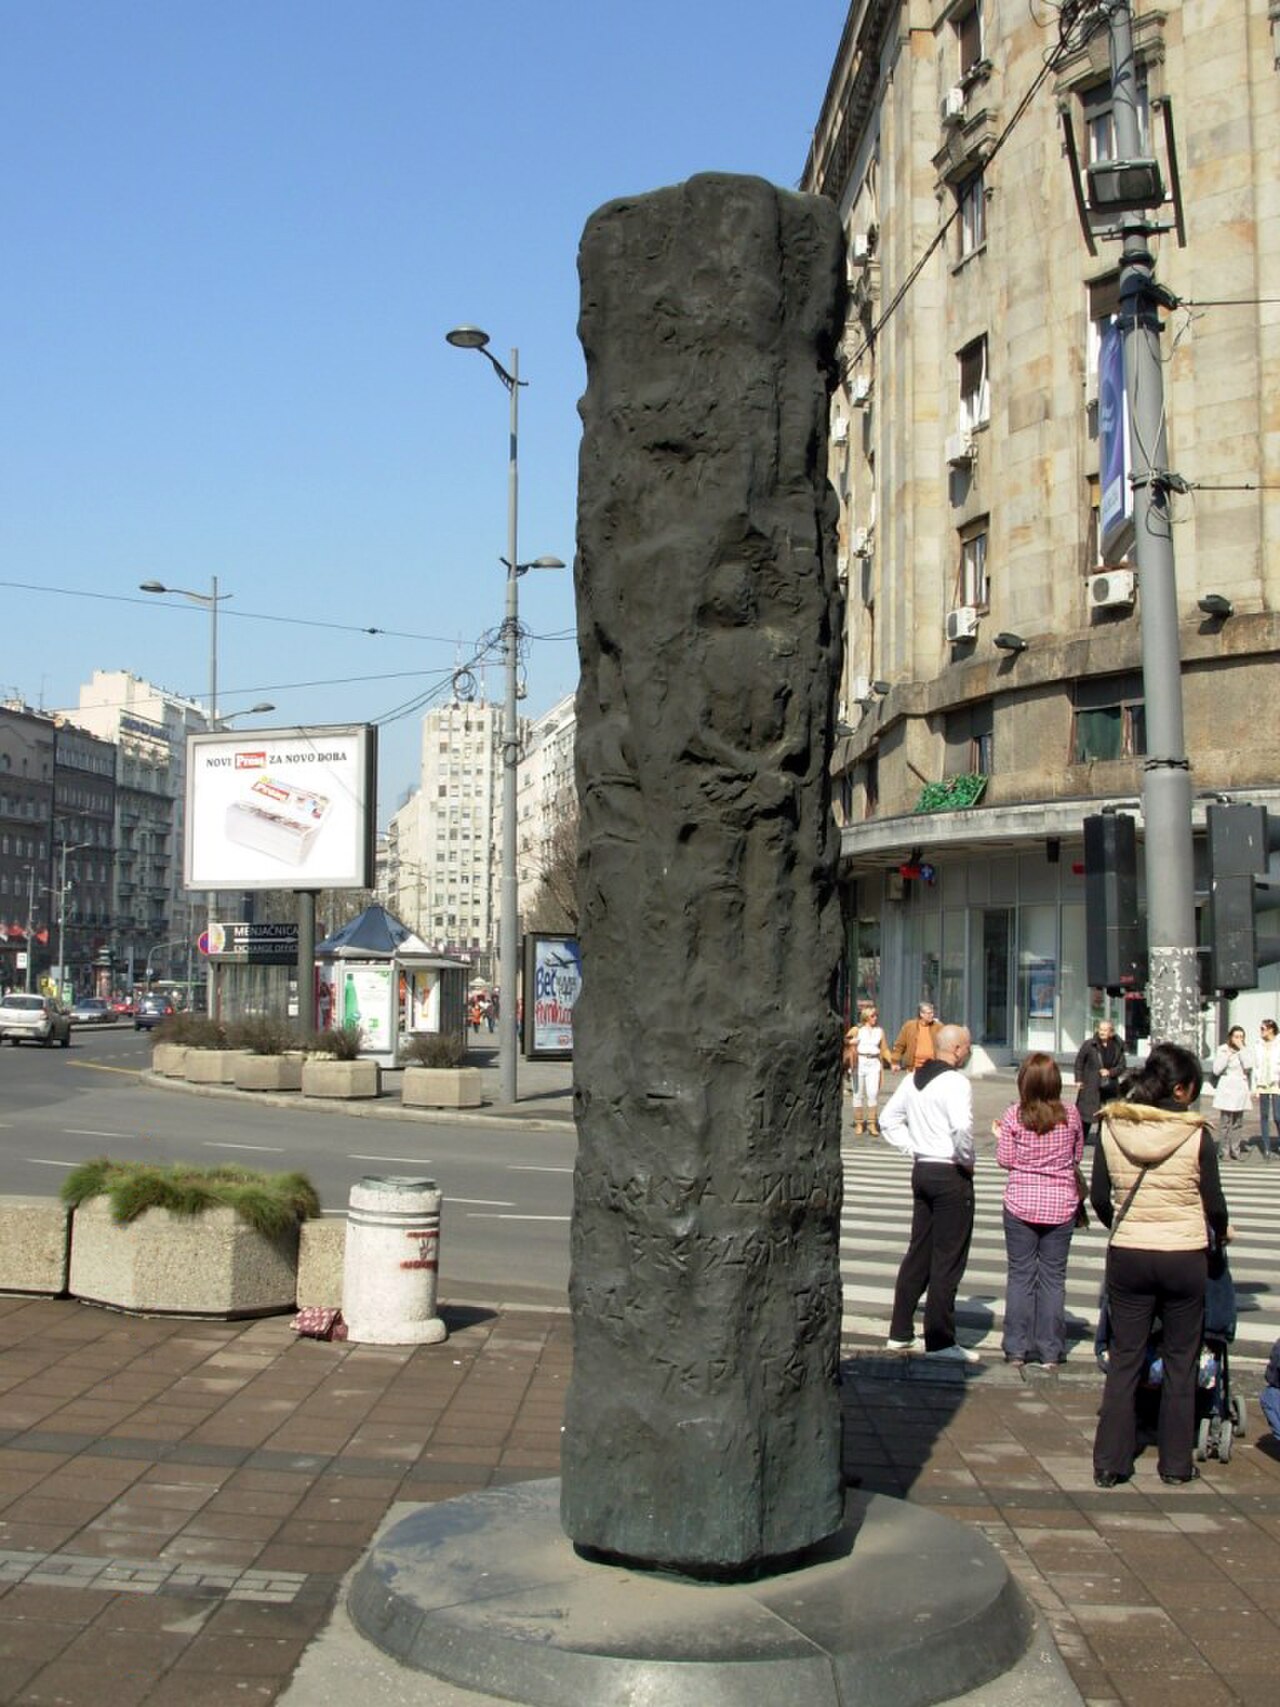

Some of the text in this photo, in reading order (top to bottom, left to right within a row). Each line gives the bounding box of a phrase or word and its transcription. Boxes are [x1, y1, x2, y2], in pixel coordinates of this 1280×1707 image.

[206, 757, 232, 768] NOVI
[269, 754, 282, 764] ZA
[285, 753, 315, 763] NOVO
[317, 752, 347, 762] DOBA
[275, 944, 298, 954] OFFIC
